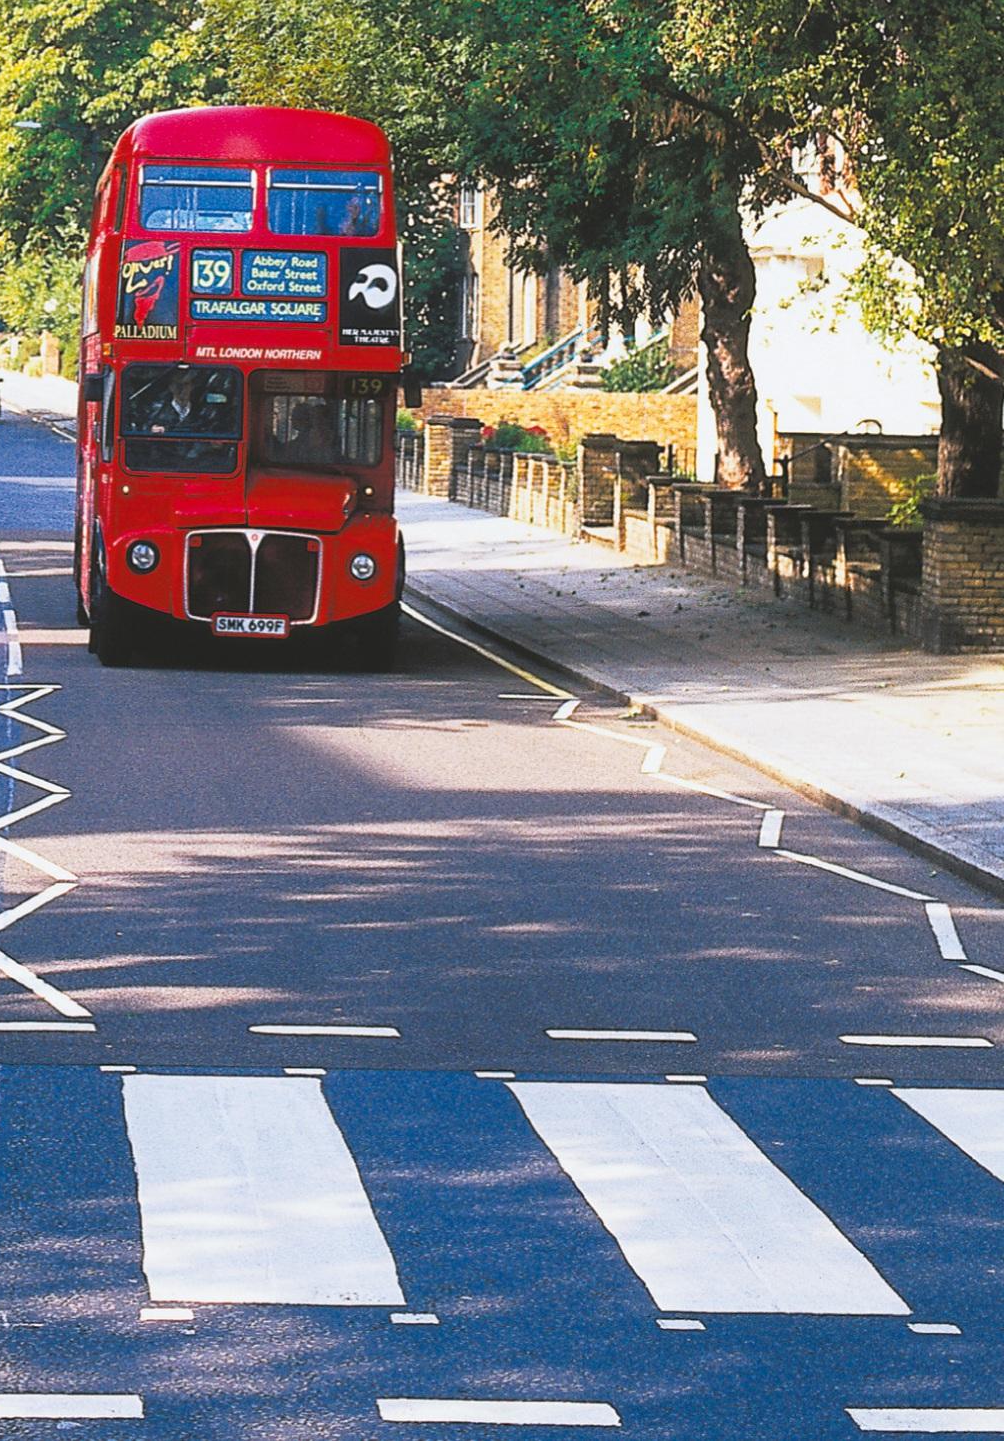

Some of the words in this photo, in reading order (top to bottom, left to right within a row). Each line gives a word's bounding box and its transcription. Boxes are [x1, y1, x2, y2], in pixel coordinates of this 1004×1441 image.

[253, 256, 287, 269] Abbey
[291, 257, 318, 268] Road
[193, 260, 230, 287] 139
[251, 268, 280, 278] Baker
[285, 269, 317, 280] Street
[247, 280, 285, 291] Oxford
[289, 281, 322, 292] Street
[194, 301, 266, 314] TRAFALGAR
[270, 303, 322, 316] SQUARE
[114, 325, 177, 339] PALLADIUM
[196, 347, 217, 357] MTL
[219, 347, 263, 359] LONDON
[264, 349, 322, 360] NORTHERN
[352, 378, 383, 395] 139
[218, 619, 245, 631] SMK
[248, 620, 283, 633] 699F
